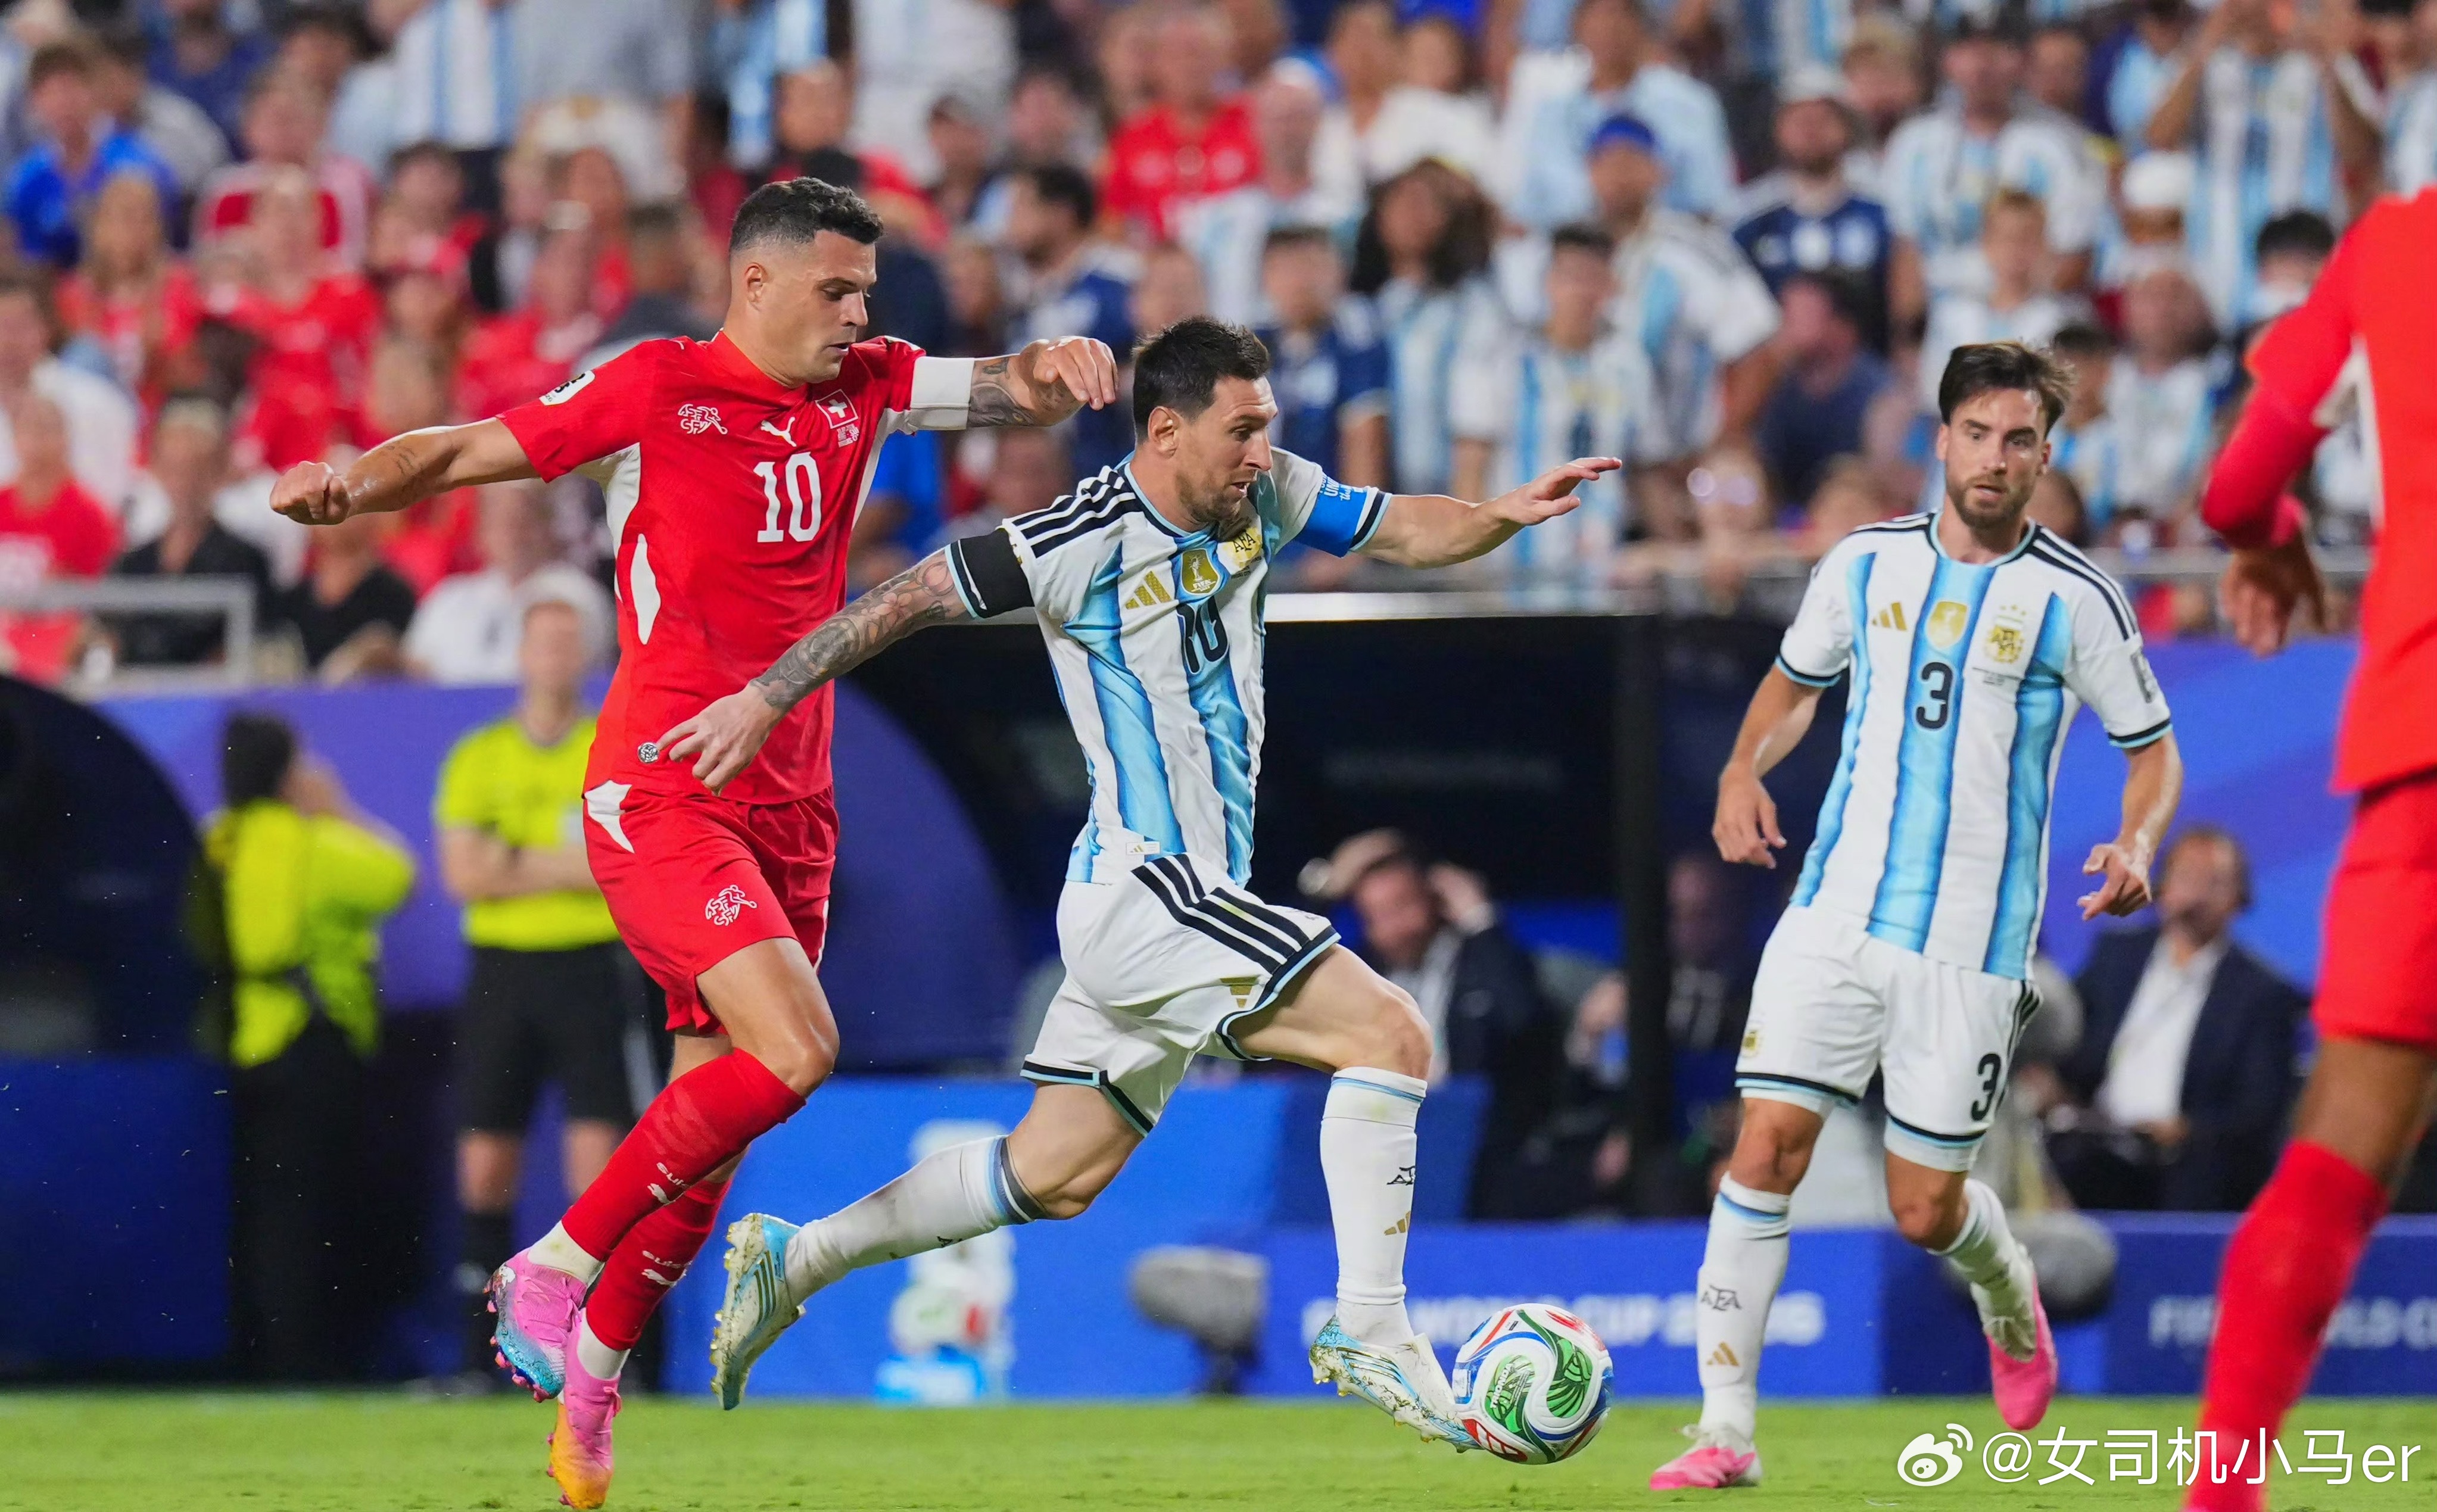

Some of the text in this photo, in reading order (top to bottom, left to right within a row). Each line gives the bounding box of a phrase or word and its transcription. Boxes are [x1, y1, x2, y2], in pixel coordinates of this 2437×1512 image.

[753, 451, 822, 543] 10
[1176, 596, 1229, 674] 10
[1916, 662, 1953, 730] 3
[1971, 1053, 2001, 1122] 3
